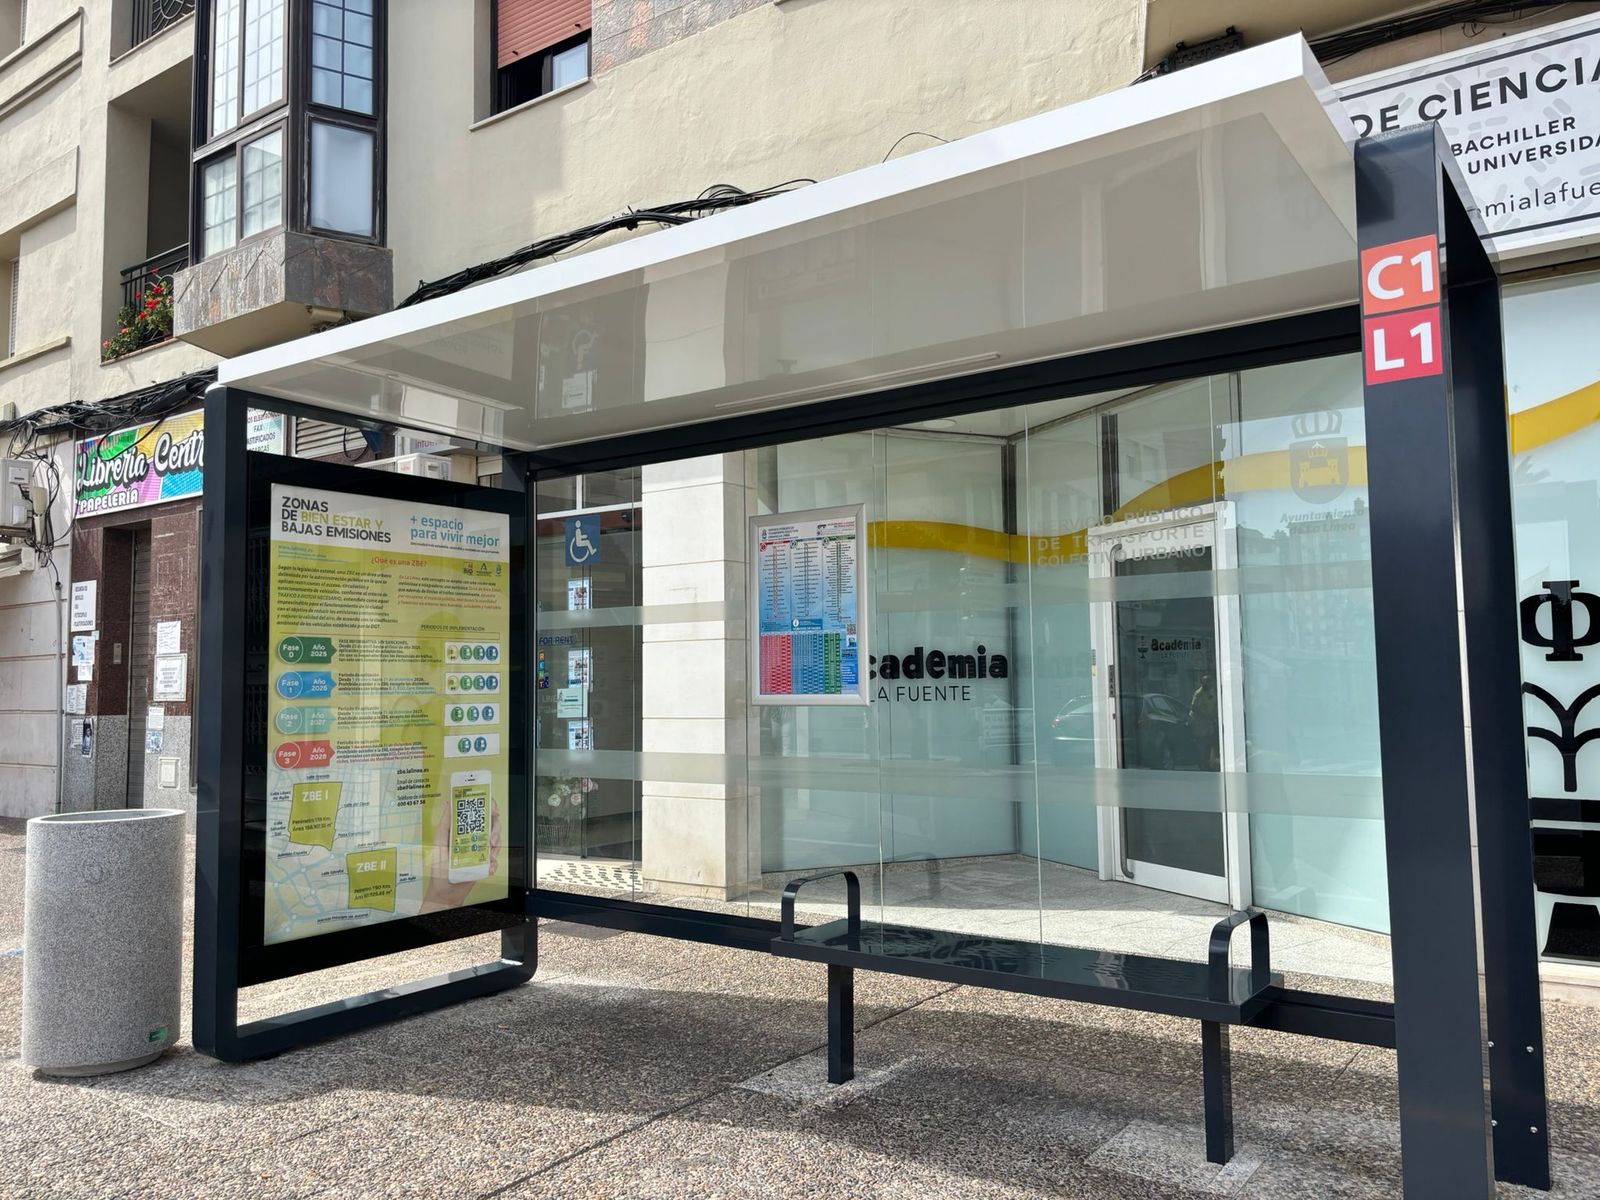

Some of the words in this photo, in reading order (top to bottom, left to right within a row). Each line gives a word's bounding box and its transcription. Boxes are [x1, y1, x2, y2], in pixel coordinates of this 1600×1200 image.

[1350, 104, 1399, 138] DE
[1451, 116, 1576, 156] BACHILLER
[1367, 250, 1434, 300] C1
[1373, 321, 1434, 372] L1
[80, 487, 138, 513] PAPELERÍA
[282, 496, 328, 513] ZONAS
[282, 509, 297, 521] DE
[301, 511, 328, 524] BIEN
[333, 515, 370, 528] ESTAR
[376, 519, 383, 528] Y
[421, 516, 463, 532] espacio
[282, 521, 322, 536] BAJAS
[326, 526, 391, 543] EMISIONES
[411, 528, 438, 541] para
[441, 530, 463, 542] vivir
[466, 533, 499, 548] mejor
[1038, 538, 1060, 551] DE
[1132, 544, 1206, 561] URBANO
[897, 686, 971, 702] FUENTE
[302, 791, 322, 802] ZBE
[356, 861, 377, 872] ZBE
